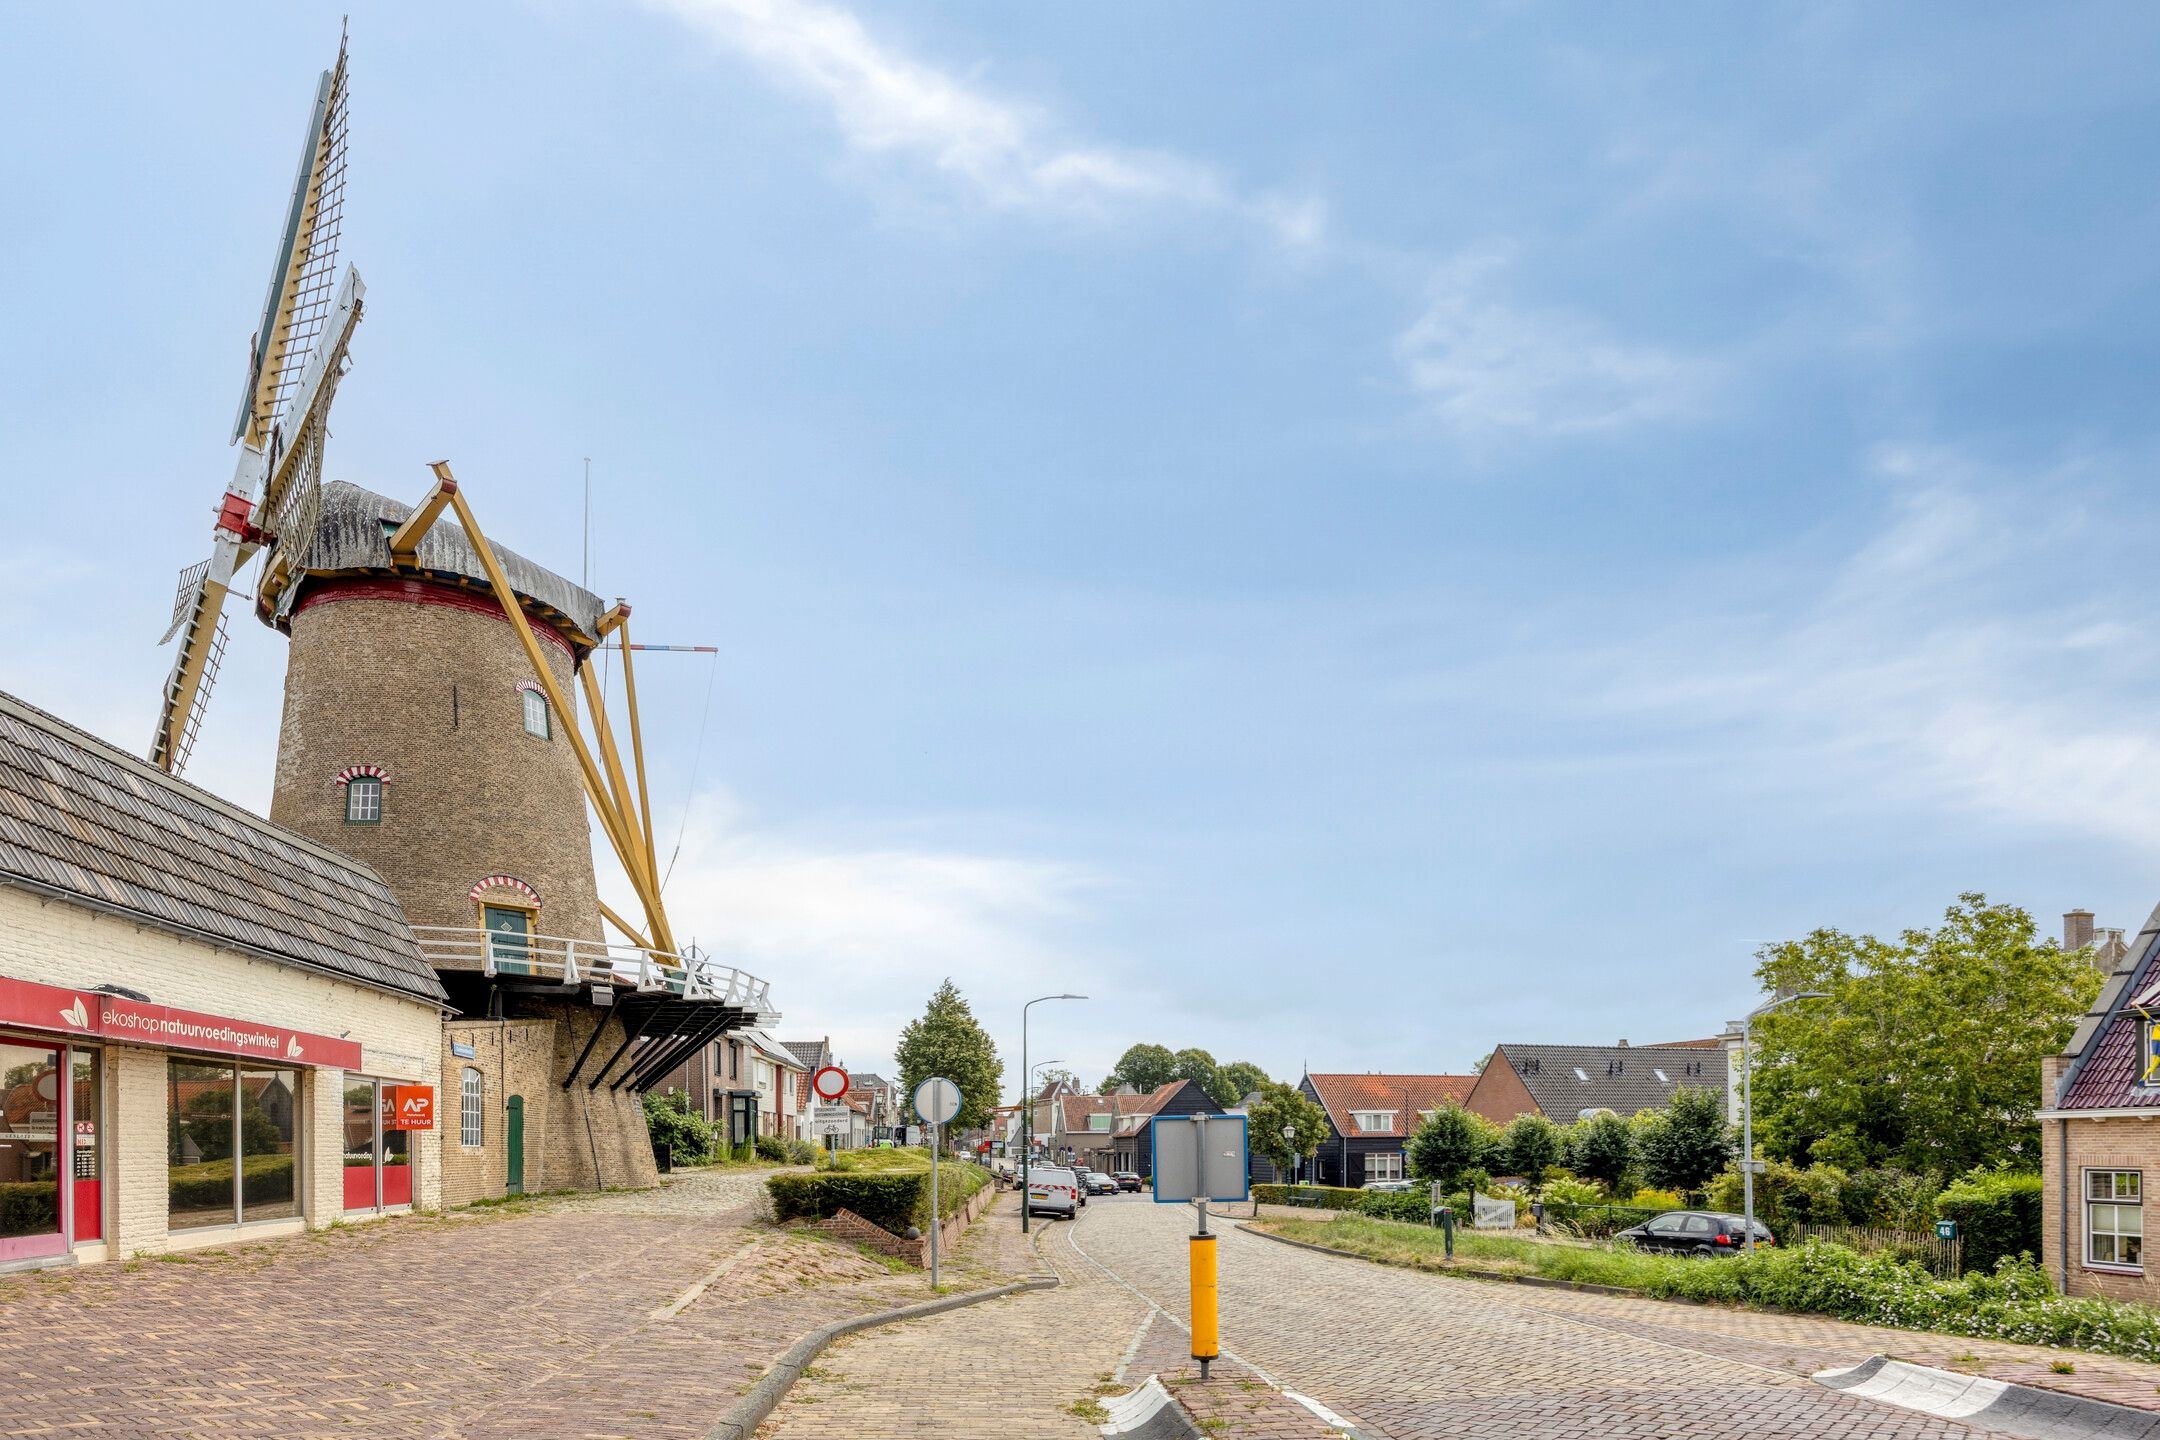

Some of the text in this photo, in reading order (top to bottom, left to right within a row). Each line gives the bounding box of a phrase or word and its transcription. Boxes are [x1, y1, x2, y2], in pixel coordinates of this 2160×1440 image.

[102, 1009, 279, 1049] ekoshop natuurvoedingswinkel
[403, 1098, 429, 1112] AP
